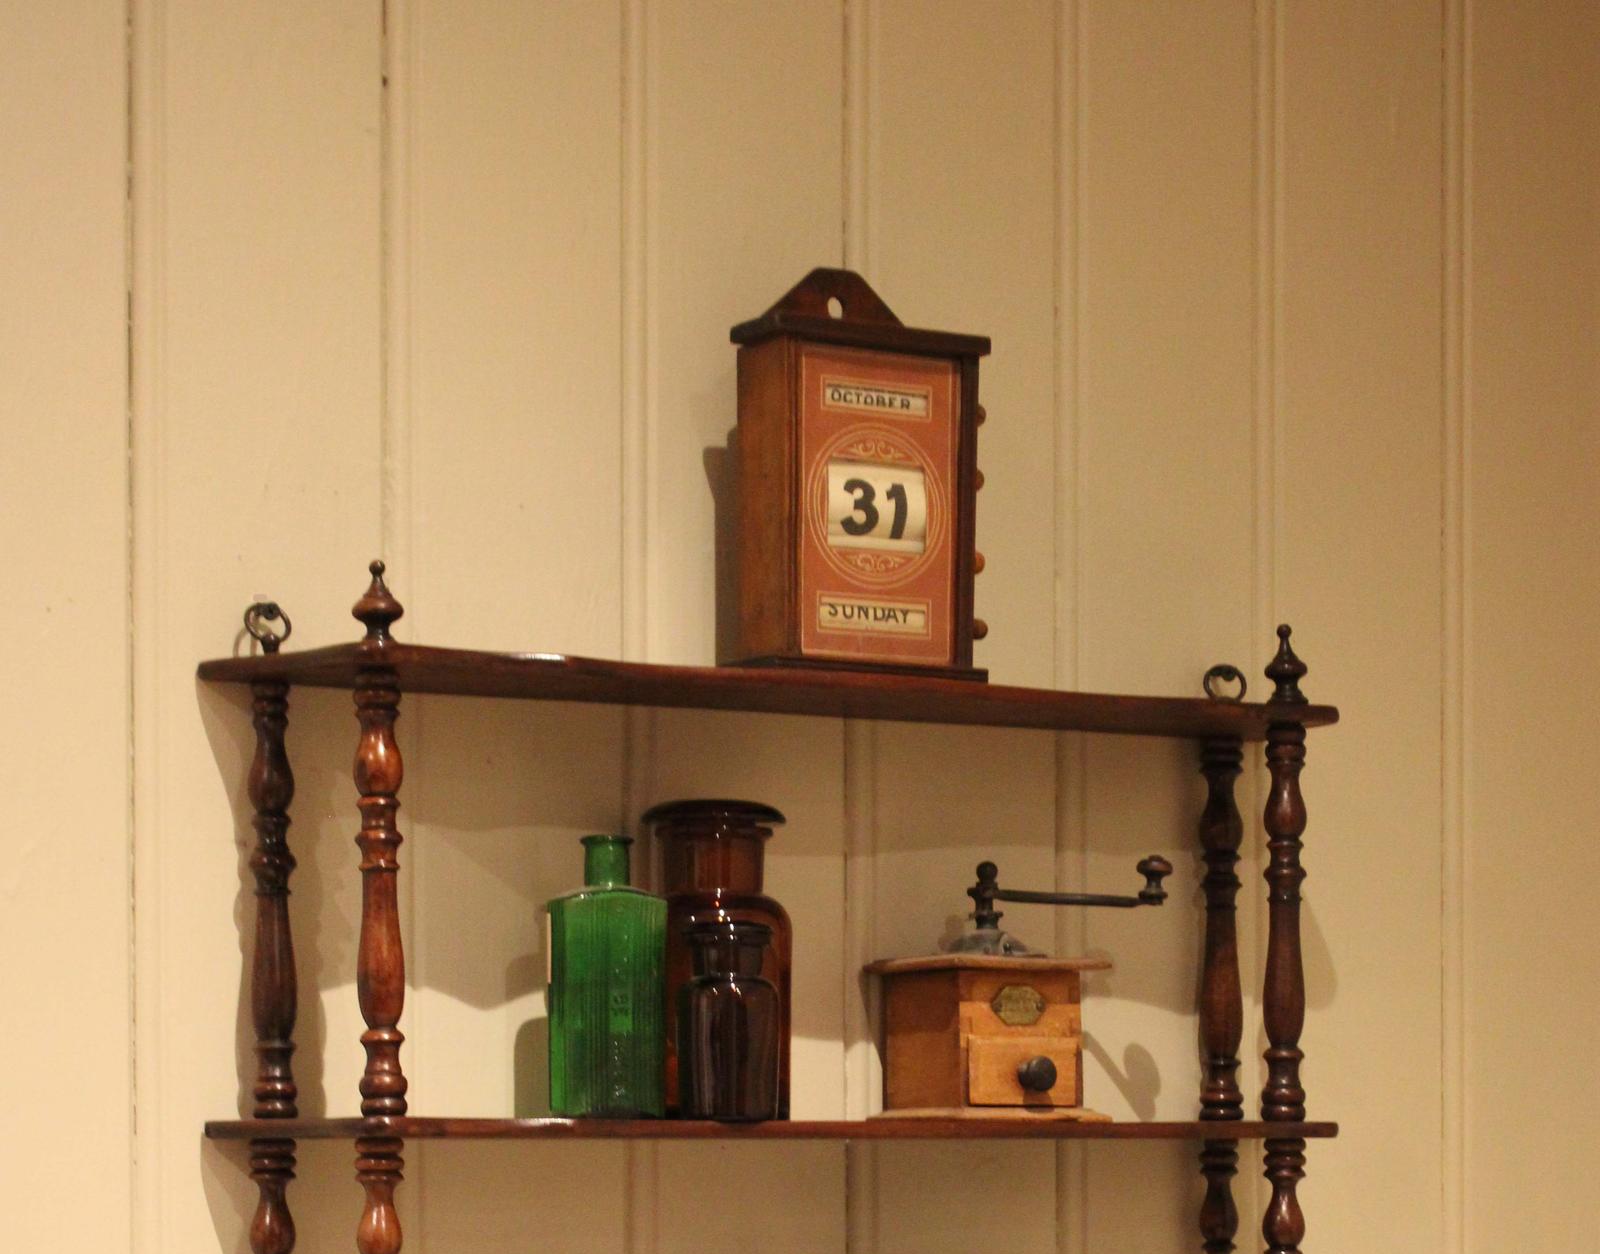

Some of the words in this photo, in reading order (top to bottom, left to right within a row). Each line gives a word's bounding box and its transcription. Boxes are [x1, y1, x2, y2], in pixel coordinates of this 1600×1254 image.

[830, 387, 912, 411] OCTOBER
[840, 478, 908, 540] 31
[828, 602, 911, 625] SUNDAY
